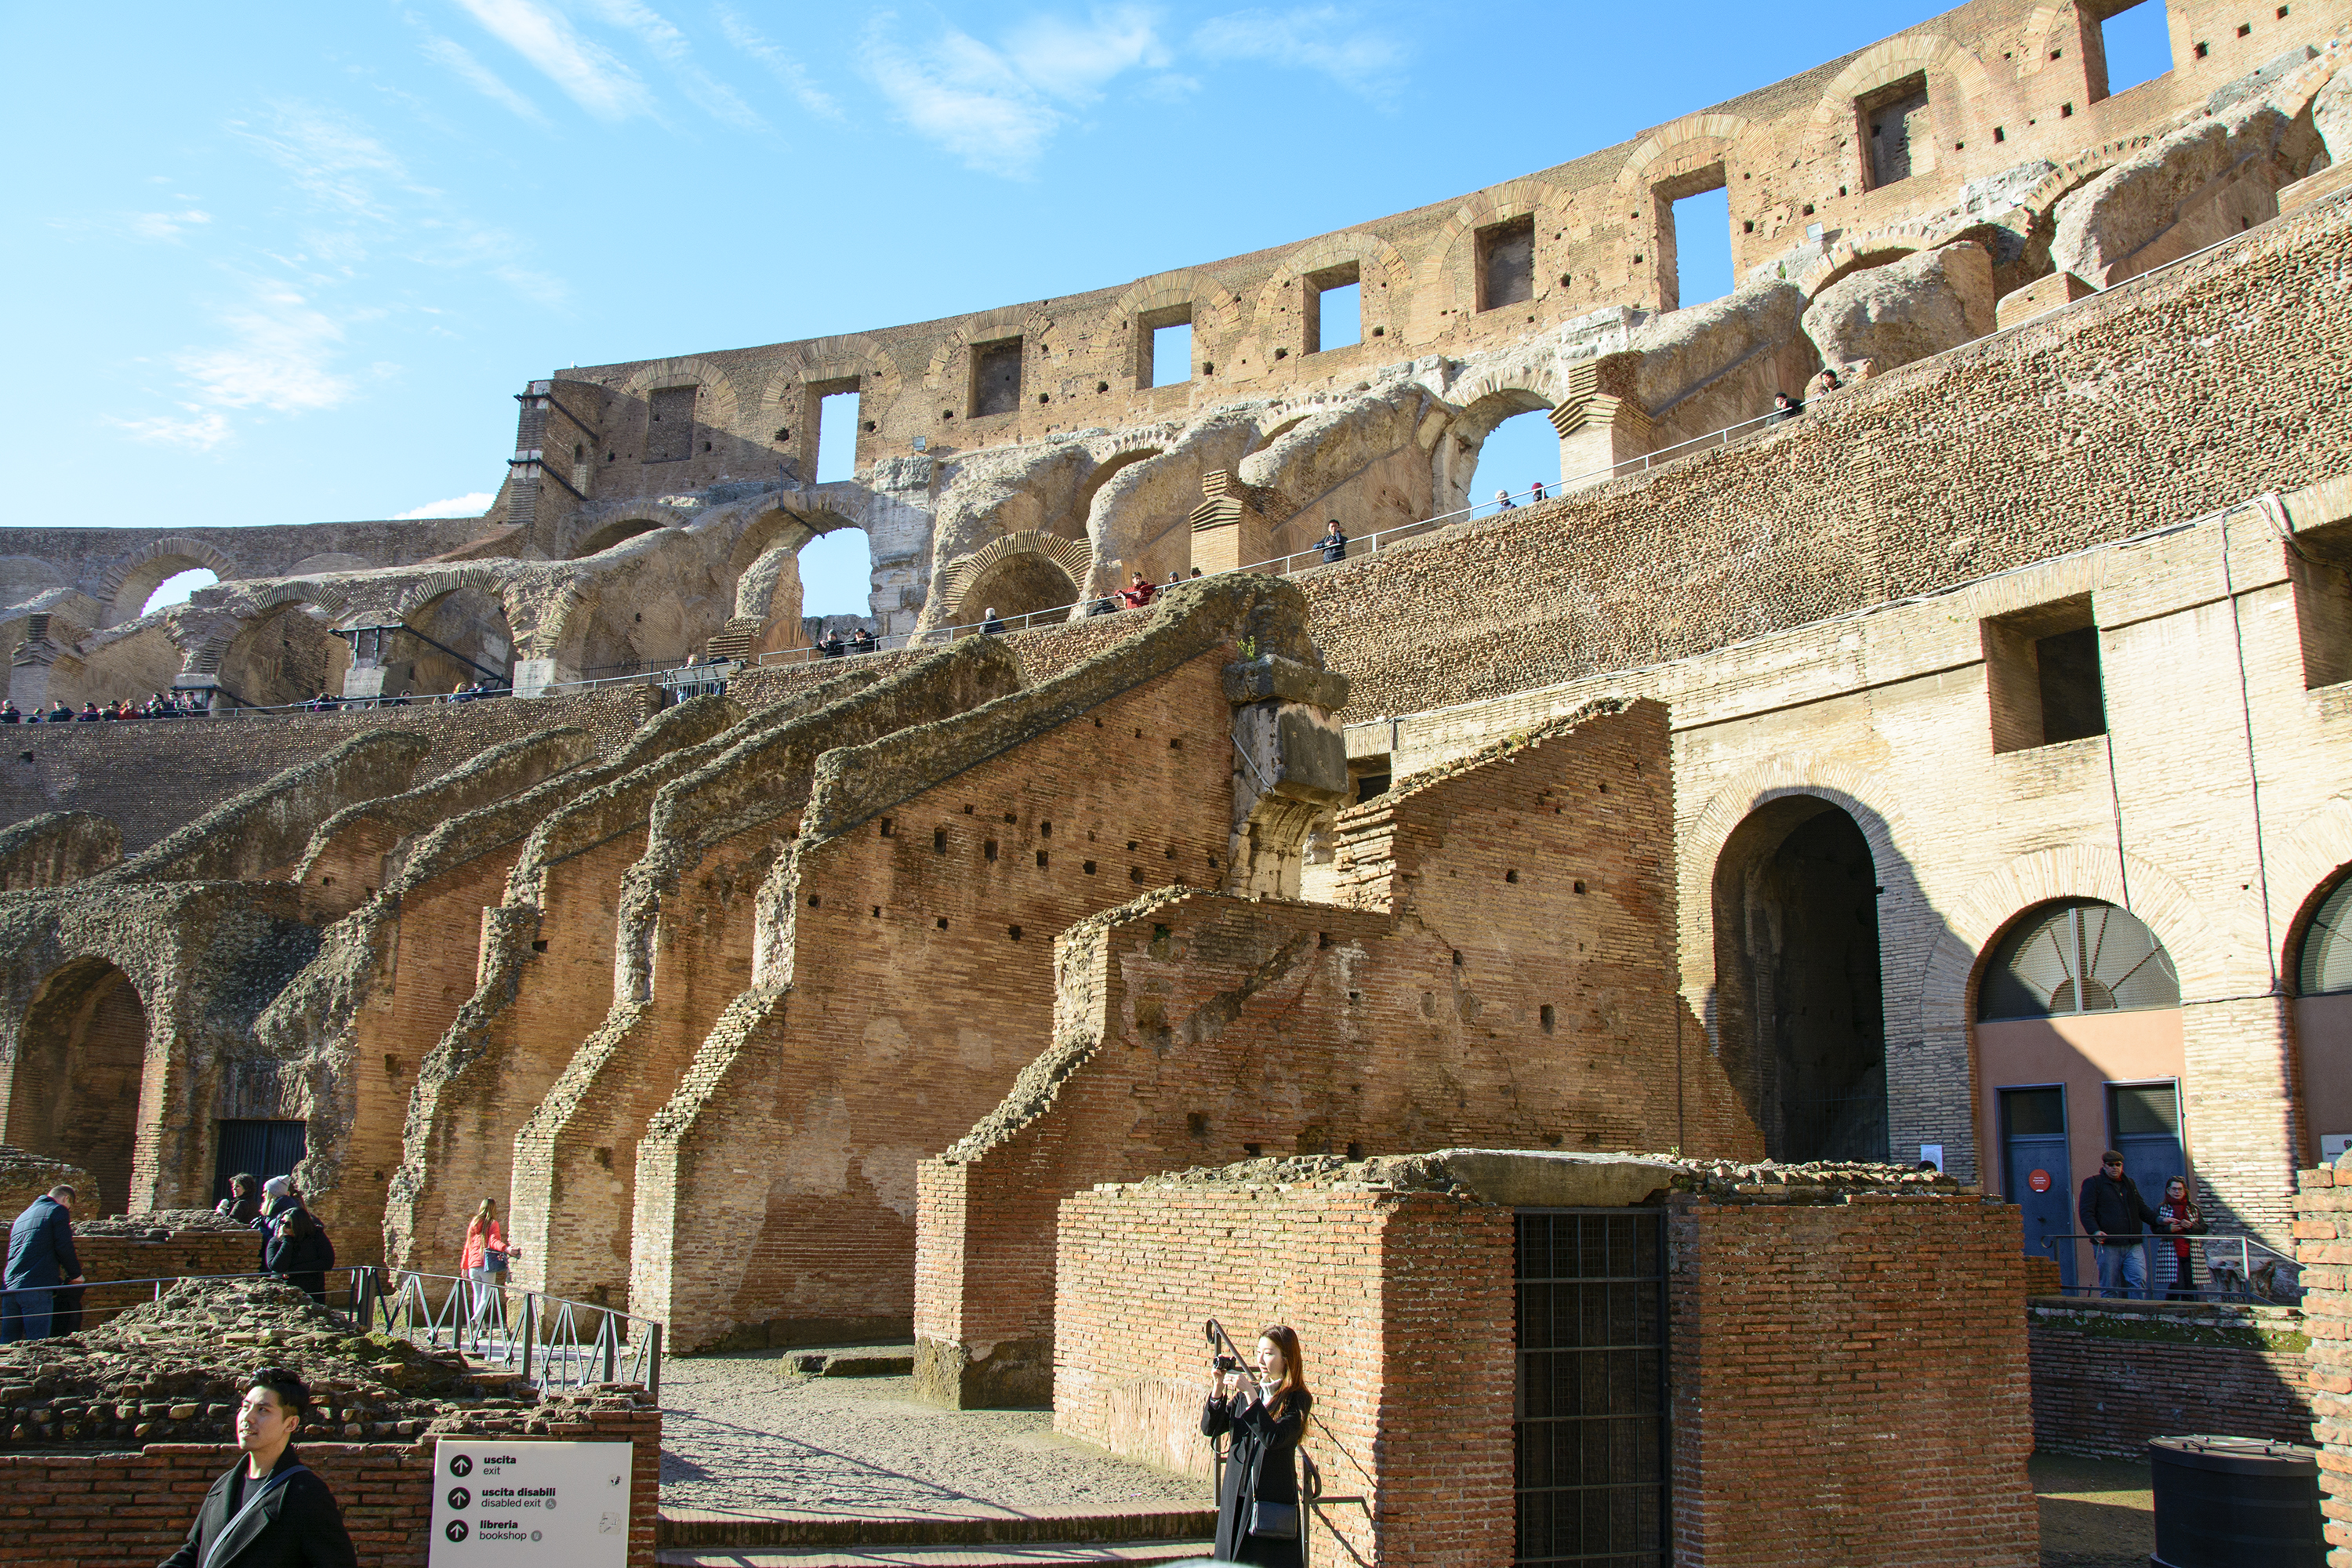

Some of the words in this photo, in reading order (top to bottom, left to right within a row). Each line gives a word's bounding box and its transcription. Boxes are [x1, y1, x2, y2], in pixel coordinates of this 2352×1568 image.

[484, 1455, 517, 1464] uscita
[483, 1466, 501, 1475] exit
[482, 1487, 514, 1497] uscita
[517, 1487, 556, 1497] disabili
[481, 1498, 521, 1507] disabled
[524, 1498, 541, 1507] exit
[480, 1520, 518, 1529] libreria
[480, 1531, 527, 1541] bookshop
